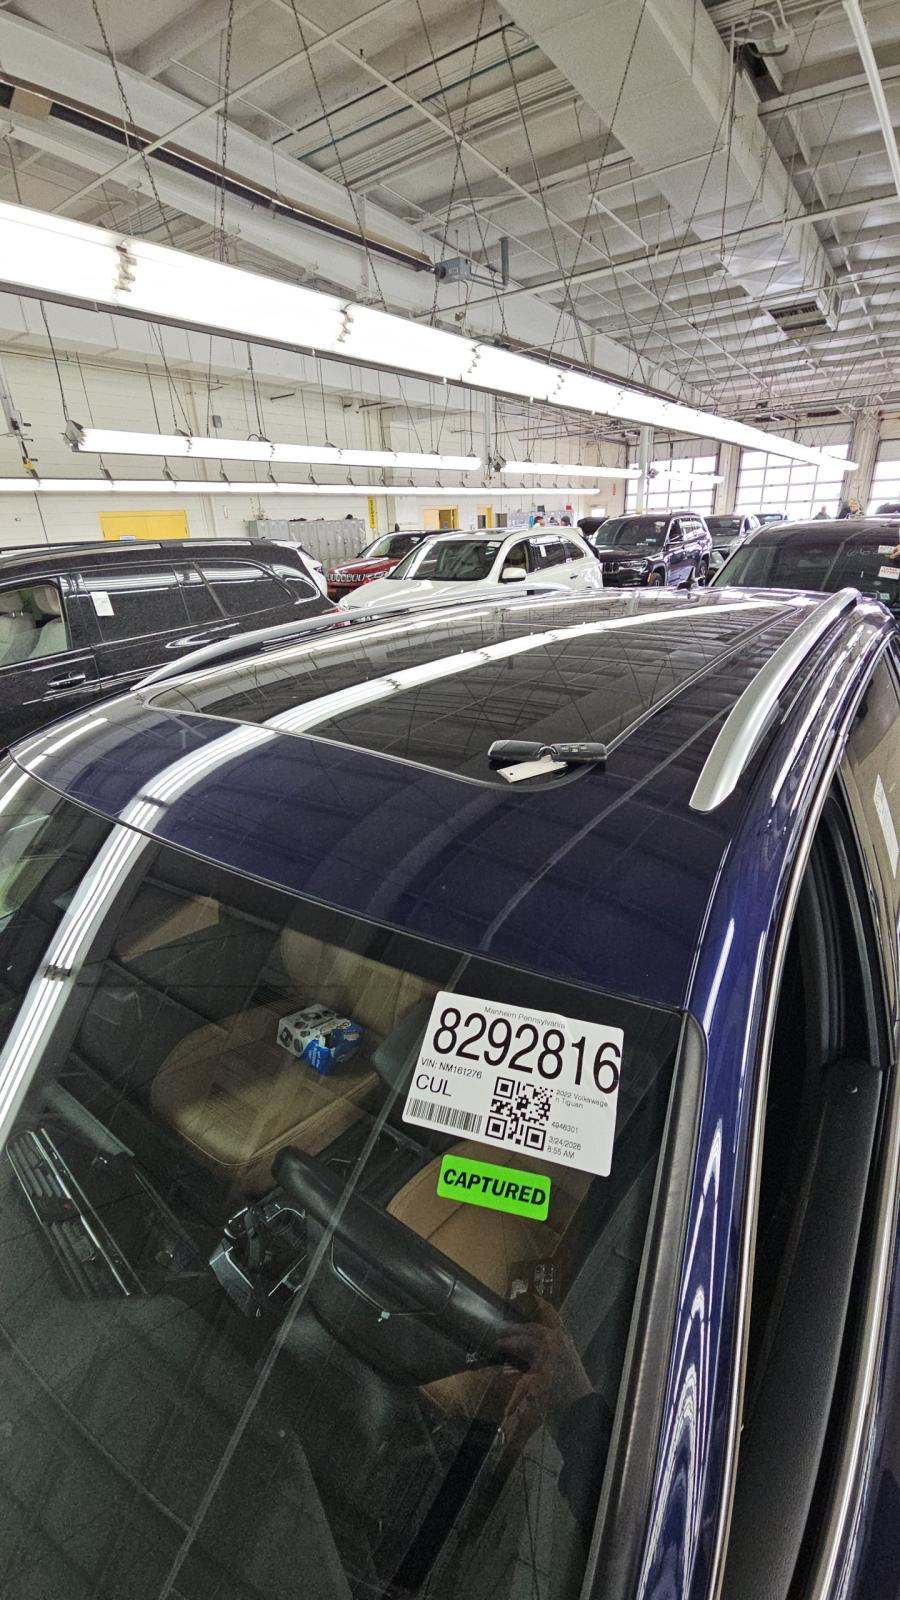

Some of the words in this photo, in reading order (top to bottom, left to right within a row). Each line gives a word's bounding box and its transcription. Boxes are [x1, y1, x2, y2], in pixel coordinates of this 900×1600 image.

[484, 1006, 517, 1019] Manheim
[518, 1013, 566, 1030] Pennsylvania
[432, 1007, 622, 1094] 8292816
[421, 1057, 438, 1069] VIN:
[438, 1062, 483, 1080] NM161276
[416, 1074, 452, 1097] CUL
[556, 1089, 572, 1098] 2022
[562, 1149, 576, 1160] AM
[443, 1168, 547, 1206] CAPTURED
